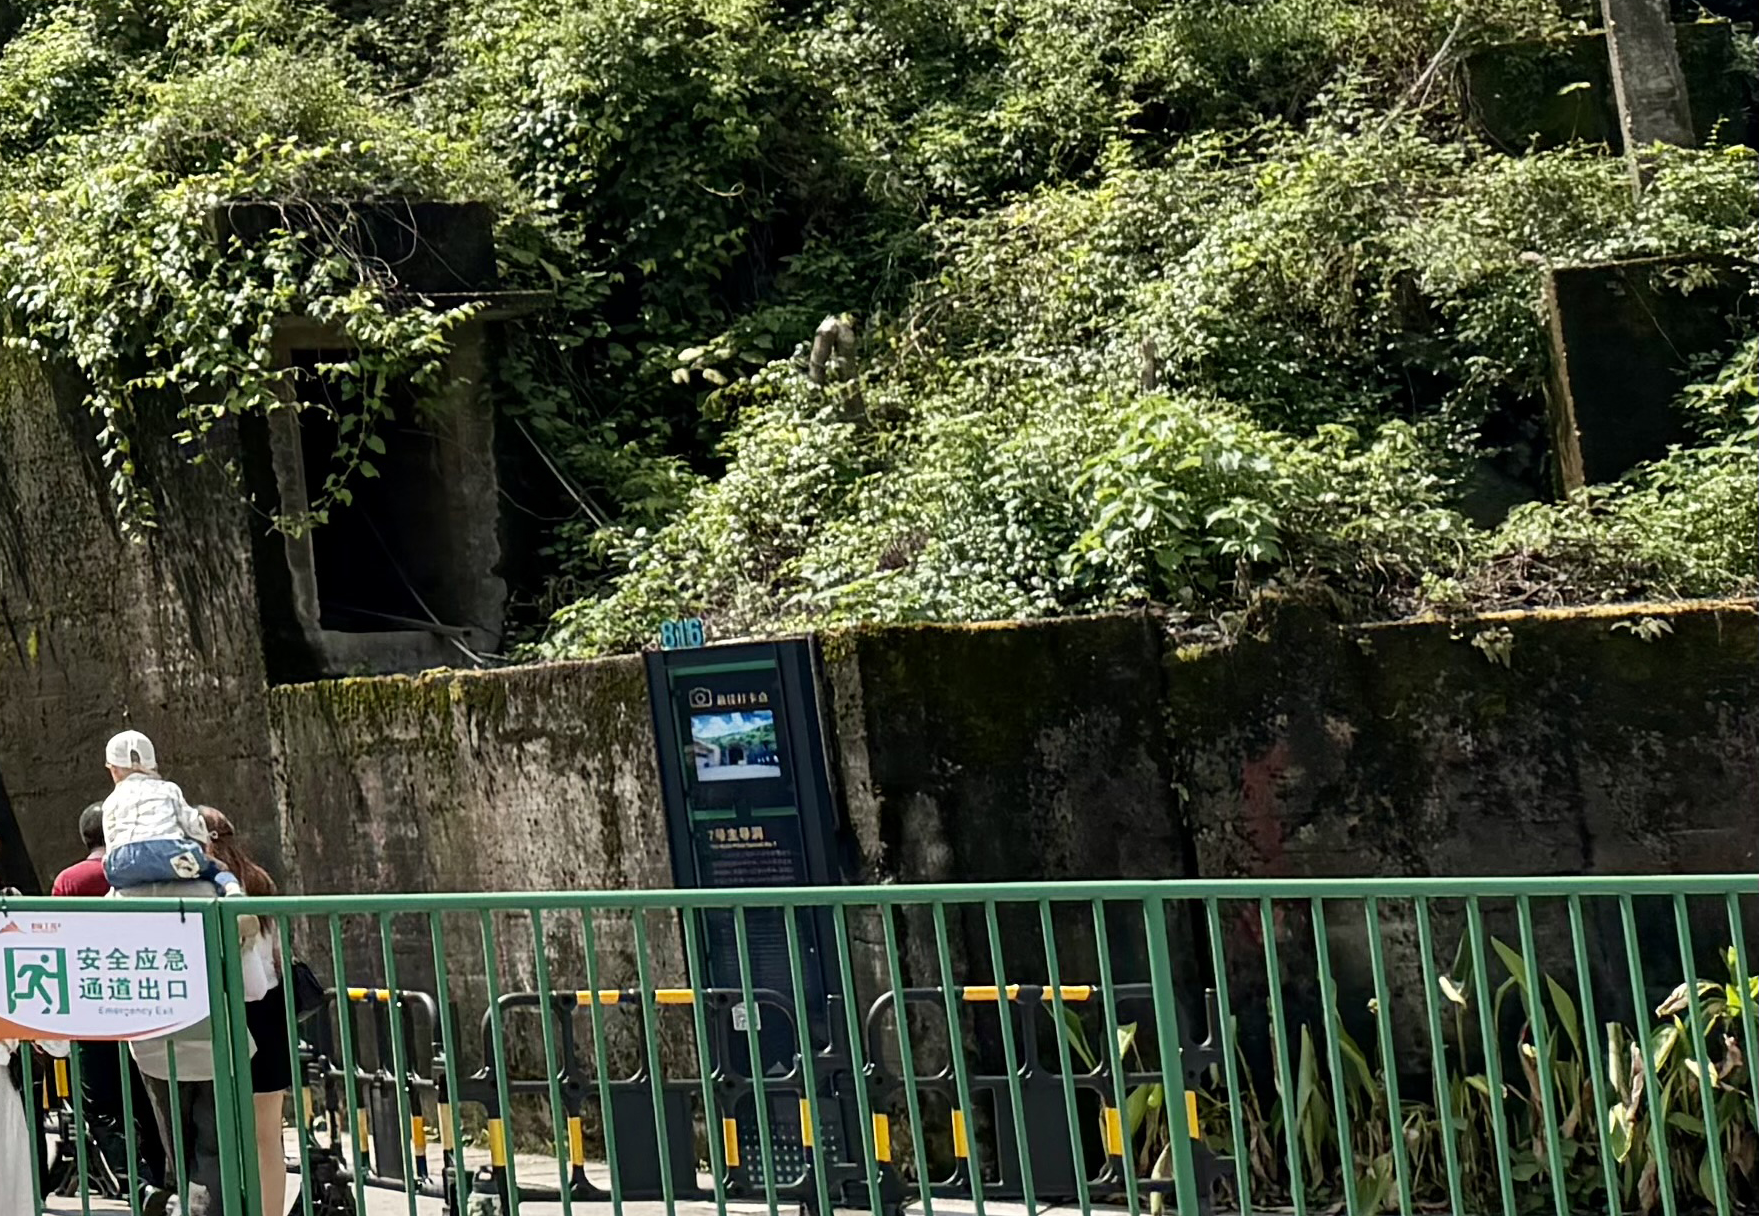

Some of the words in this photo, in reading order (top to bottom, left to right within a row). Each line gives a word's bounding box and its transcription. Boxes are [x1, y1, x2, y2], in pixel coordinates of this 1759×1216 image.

[660, 618, 705, 650] 816
[76, 947, 188, 971] 安全应急
[78, 977, 188, 1000] 通道出口
[98, 1006, 152, 1017] Emergency
